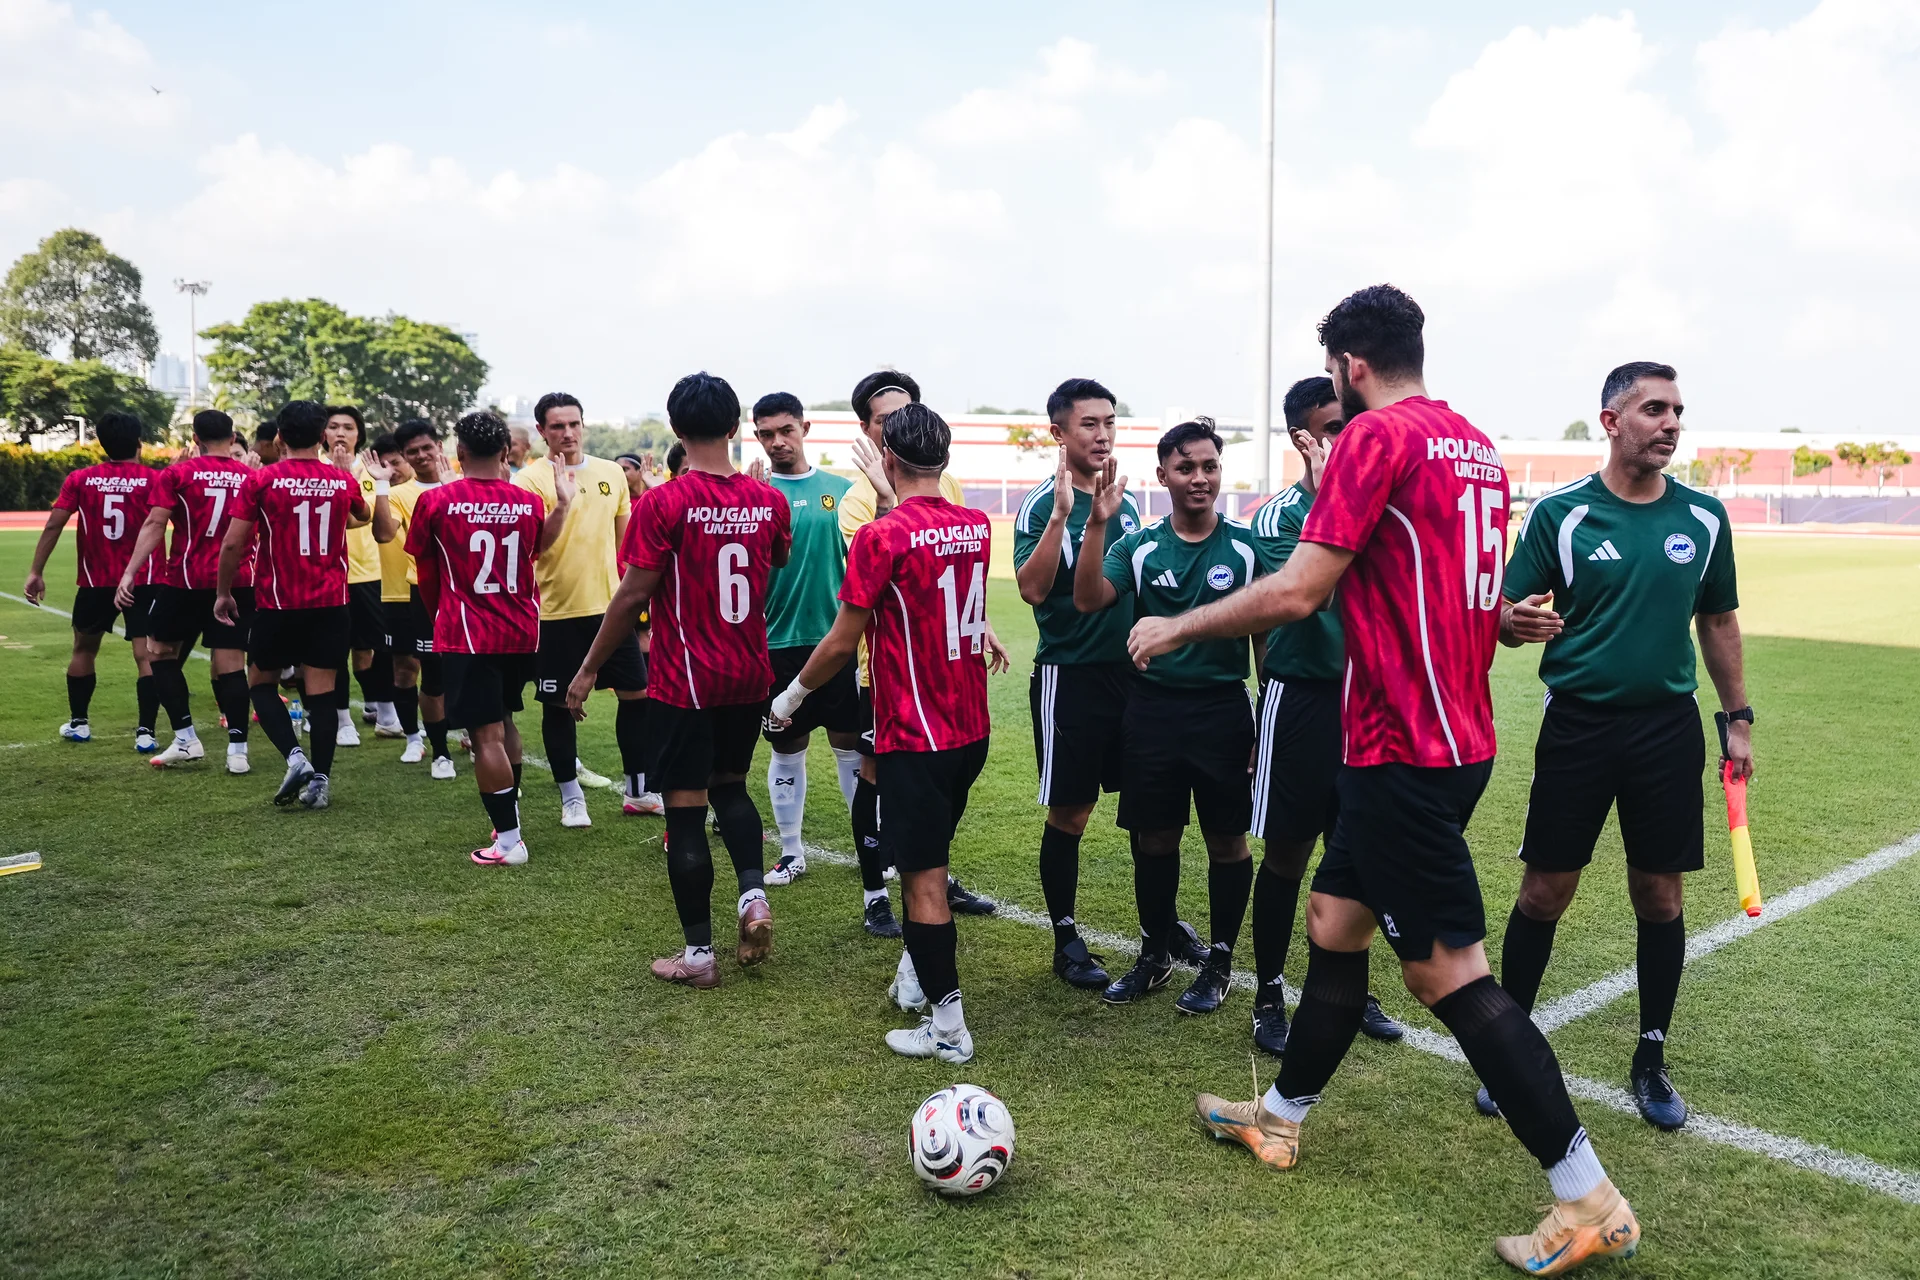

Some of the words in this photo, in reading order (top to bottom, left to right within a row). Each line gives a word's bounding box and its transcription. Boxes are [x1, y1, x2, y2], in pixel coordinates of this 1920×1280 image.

[1427, 437, 1502, 468] HOUGAN
[193, 471, 247, 483] HOUGA
[1454, 461, 1502, 483] UNITED
[85, 477, 148, 487] HOUGANG
[97, 485, 134, 493] UNITED
[208, 479, 242, 488] UNITE
[272, 478, 347, 490] HOUGANG
[290, 488, 335, 497] UNITED
[103, 494, 125, 540] 5
[204, 488, 239, 537] 7
[447, 502, 533, 516] HOUGANG
[687, 506, 773, 523] HOUGANG
[467, 514, 519, 524] UNITED
[293, 500, 331, 556] 11
[704, 522, 759, 534] UNITED
[910, 524, 989, 549] HOUGANG
[935, 540, 982, 557] UNITED
[1458, 483, 1504, 611] 15
[469, 530, 520, 594] 21
[718, 542, 750, 624] 6
[937, 562, 986, 661] 14
[384, 633, 393, 646] 11
[539, 678, 557, 693] 16
